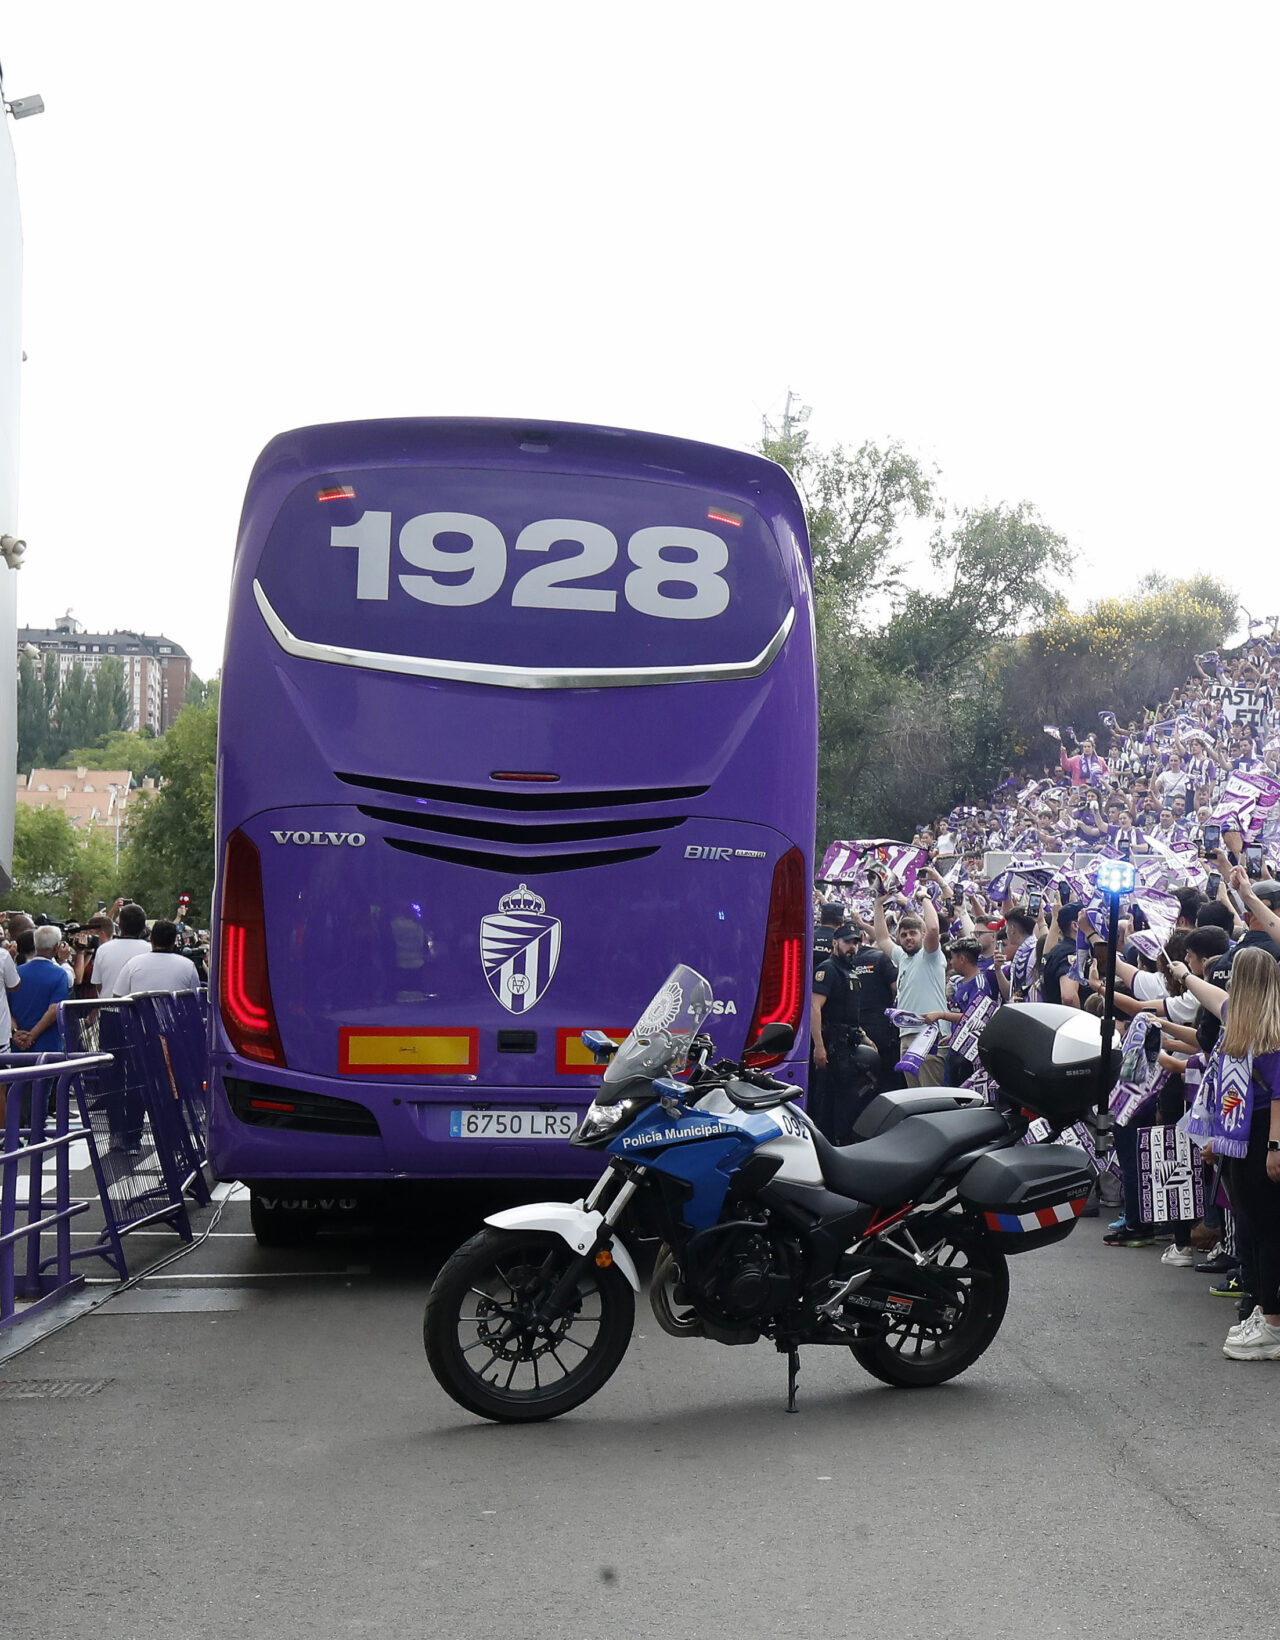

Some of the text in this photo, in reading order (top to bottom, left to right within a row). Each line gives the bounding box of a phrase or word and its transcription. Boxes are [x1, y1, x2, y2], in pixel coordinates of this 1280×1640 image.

[329, 509, 731, 620] 1928
[270, 830, 366, 847] VOLVO
[684, 845, 733, 861] B11R
[466, 1114, 523, 1135] 6750
[530, 1115, 572, 1135] LRS
[622, 1122, 723, 1149] Policía Municipal
[256, 1196, 357, 1211] VOLVO
